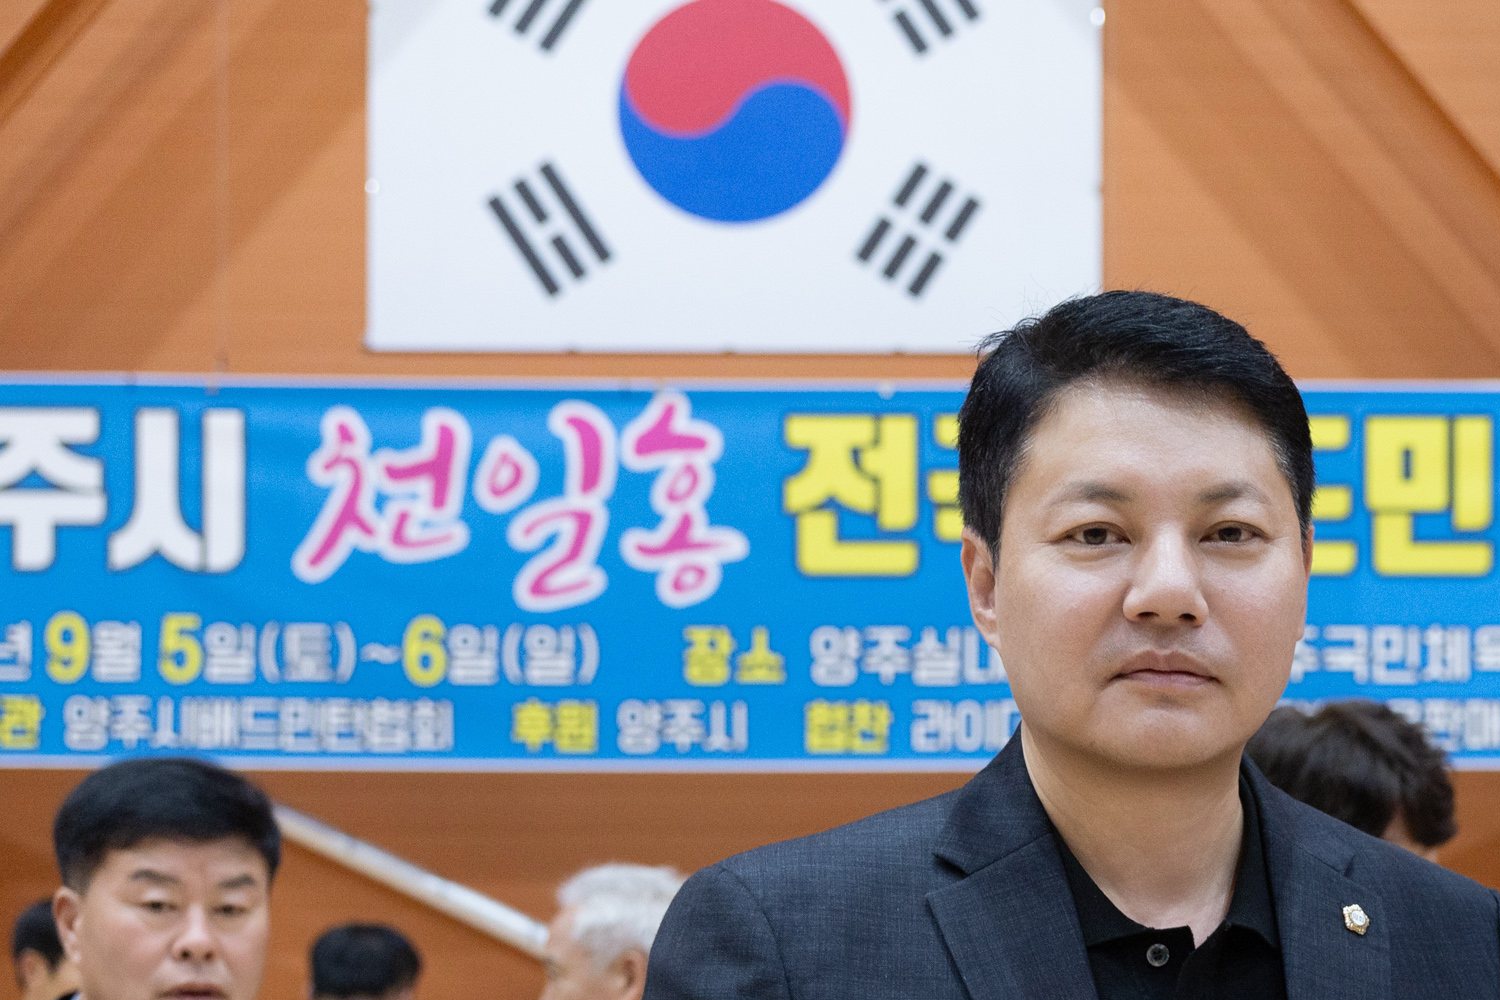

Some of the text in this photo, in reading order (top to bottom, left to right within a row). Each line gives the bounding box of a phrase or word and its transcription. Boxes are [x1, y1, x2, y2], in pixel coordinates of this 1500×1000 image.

[291, 390, 750, 613] 천일홍
[783, 412, 964, 577] 전
[43, 609, 142, 684] 9월
[682, 624, 788, 687] 장소
[511, 698, 599, 754] 후원
[615, 698, 749, 754] 양주시
[803, 698, 894, 755] 협찬
